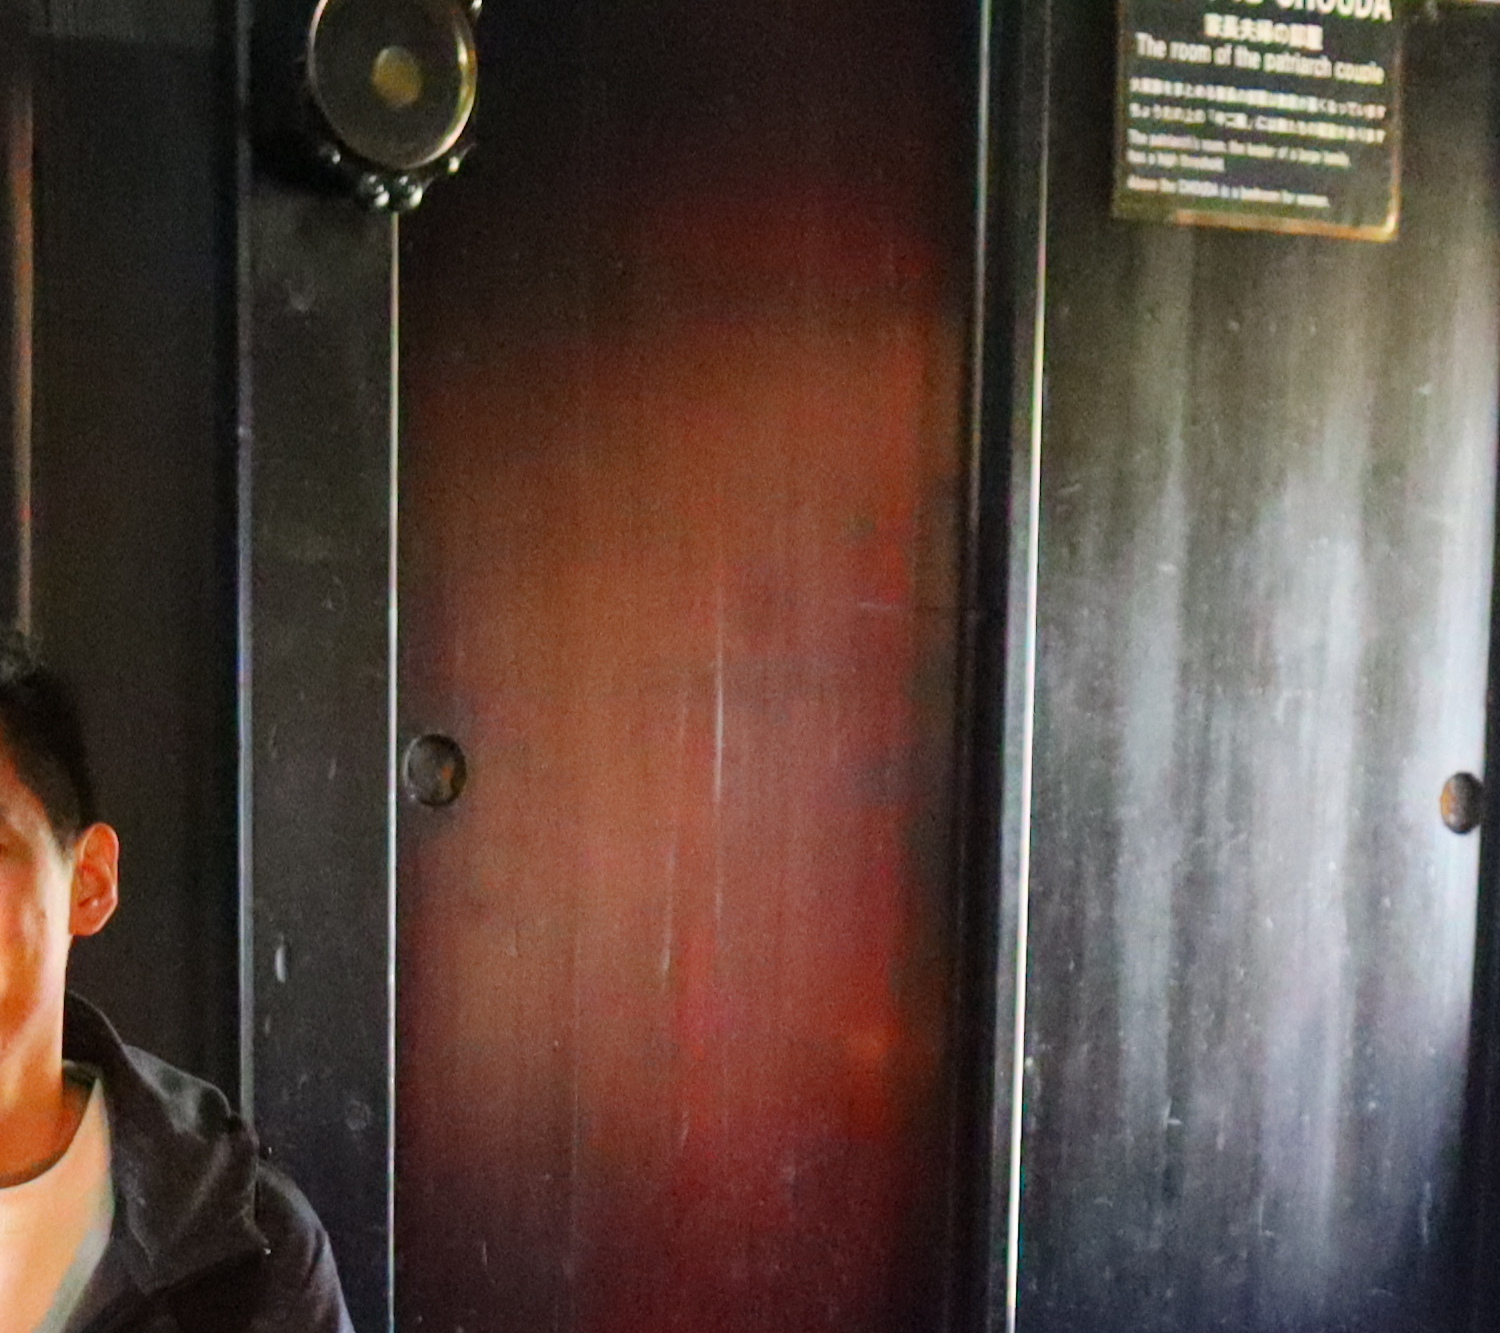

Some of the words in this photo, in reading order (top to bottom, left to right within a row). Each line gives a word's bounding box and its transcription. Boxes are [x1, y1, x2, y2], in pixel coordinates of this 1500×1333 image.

[1277, 0, 1393, 22] OUDA
[1135, 31, 1168, 59] The
[1169, 42, 1212, 64] room
[1214, 43, 1233, 66] of
[1234, 45, 1261, 70] the
[1263, 52, 1332, 78] patriarch
[1333, 61, 1385, 85] couple
